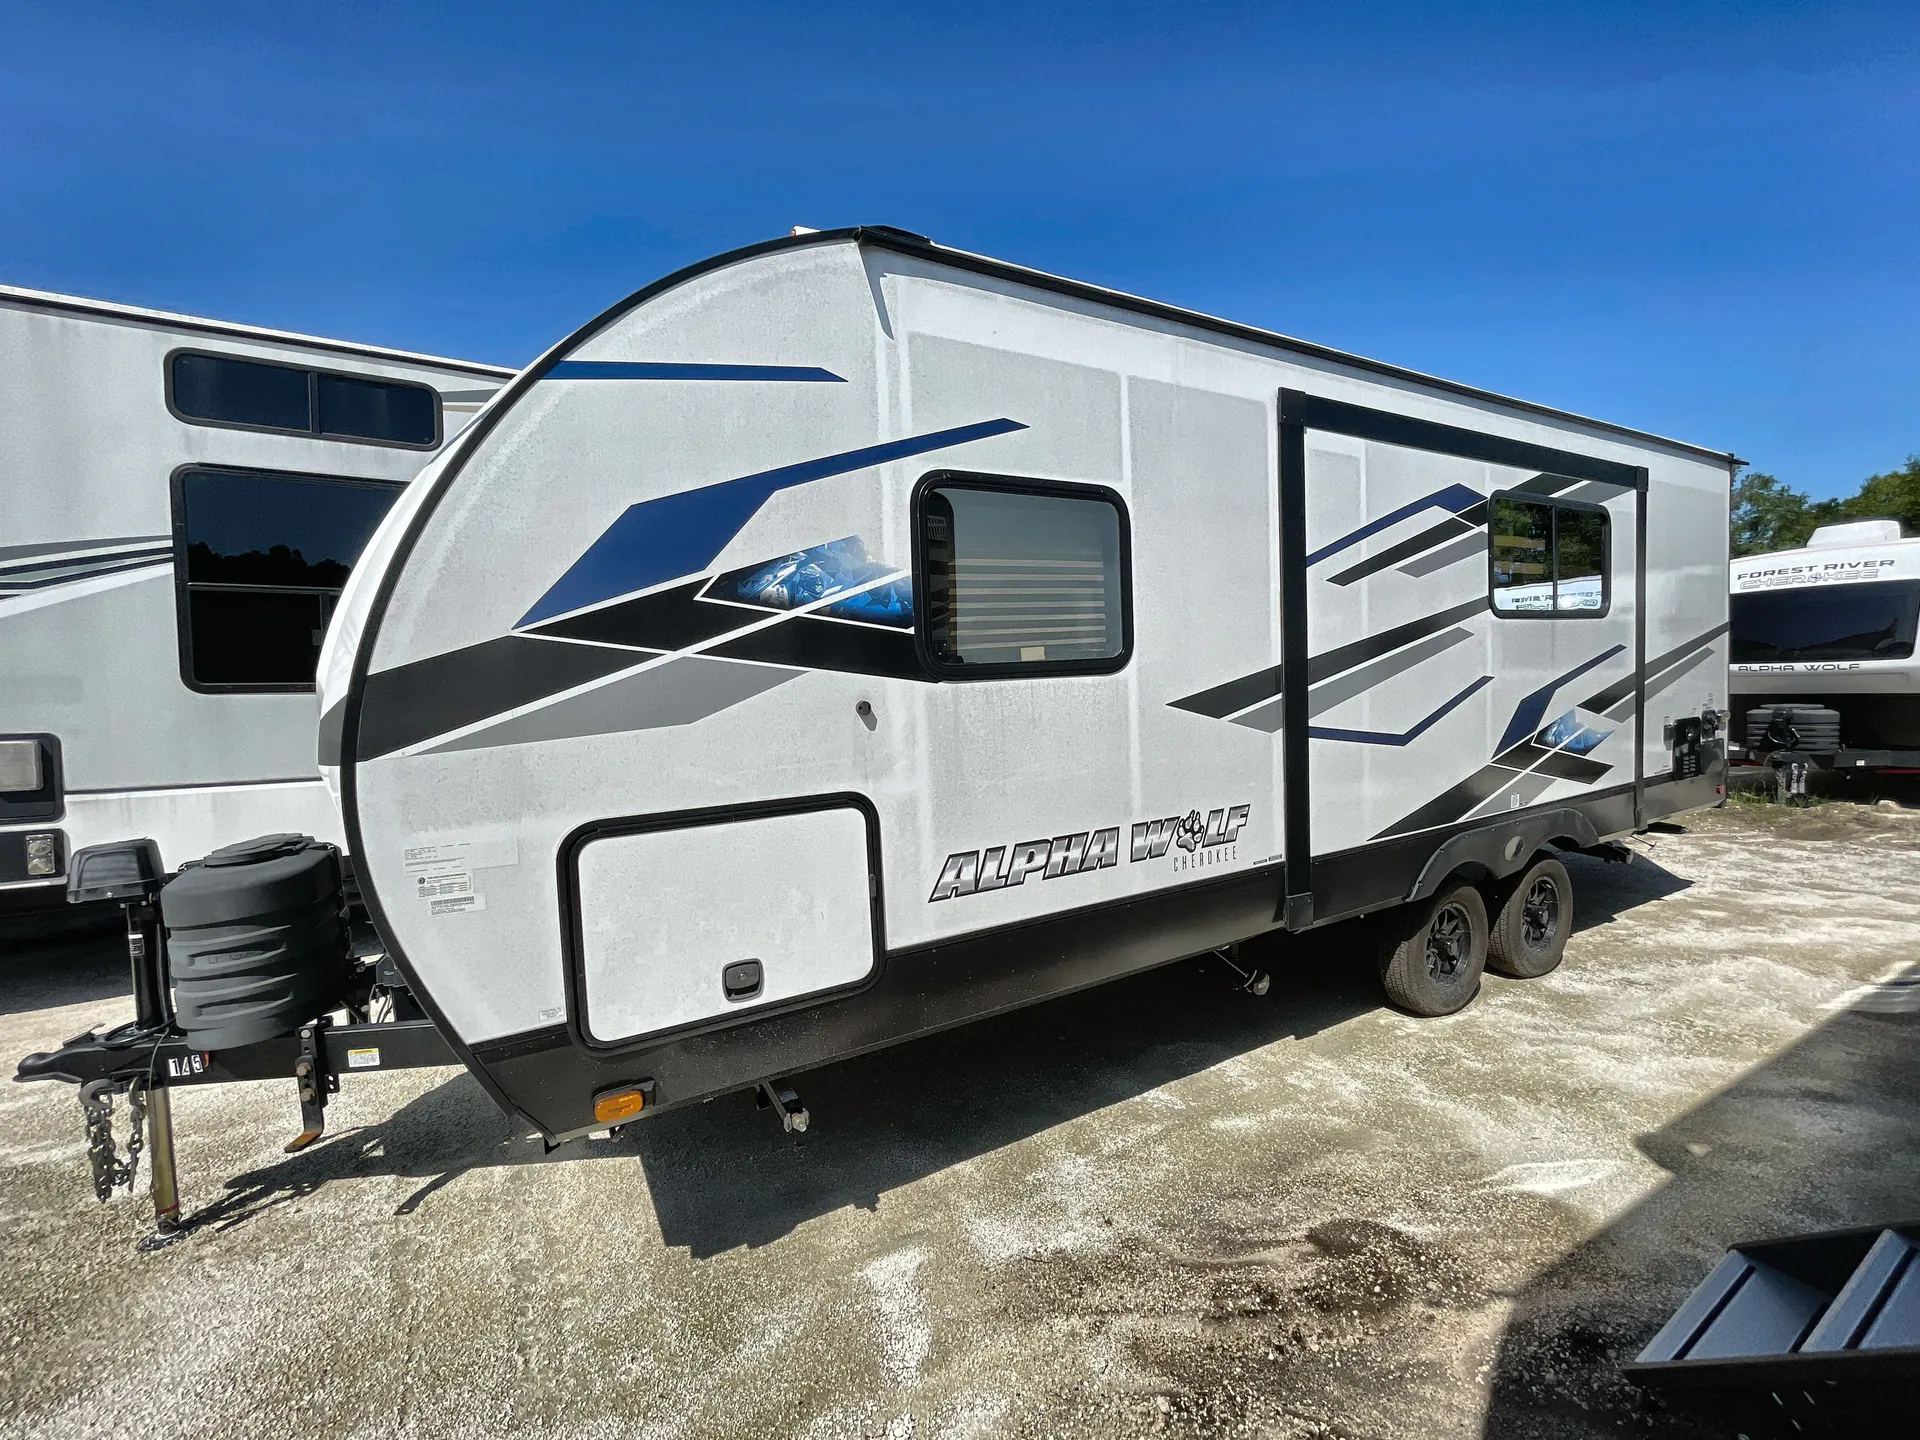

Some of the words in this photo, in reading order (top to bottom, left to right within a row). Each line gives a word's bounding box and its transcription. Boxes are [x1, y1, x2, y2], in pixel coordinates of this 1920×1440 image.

[1737, 565, 1819, 580] FOREST
[1823, 559, 1895, 571] RIVER
[1738, 664, 1794, 672] ALPHA
[1803, 663, 1860, 671] WOLF
[927, 826, 1120, 903] ALPHA
[1173, 845, 1237, 872] CHEROKEE
